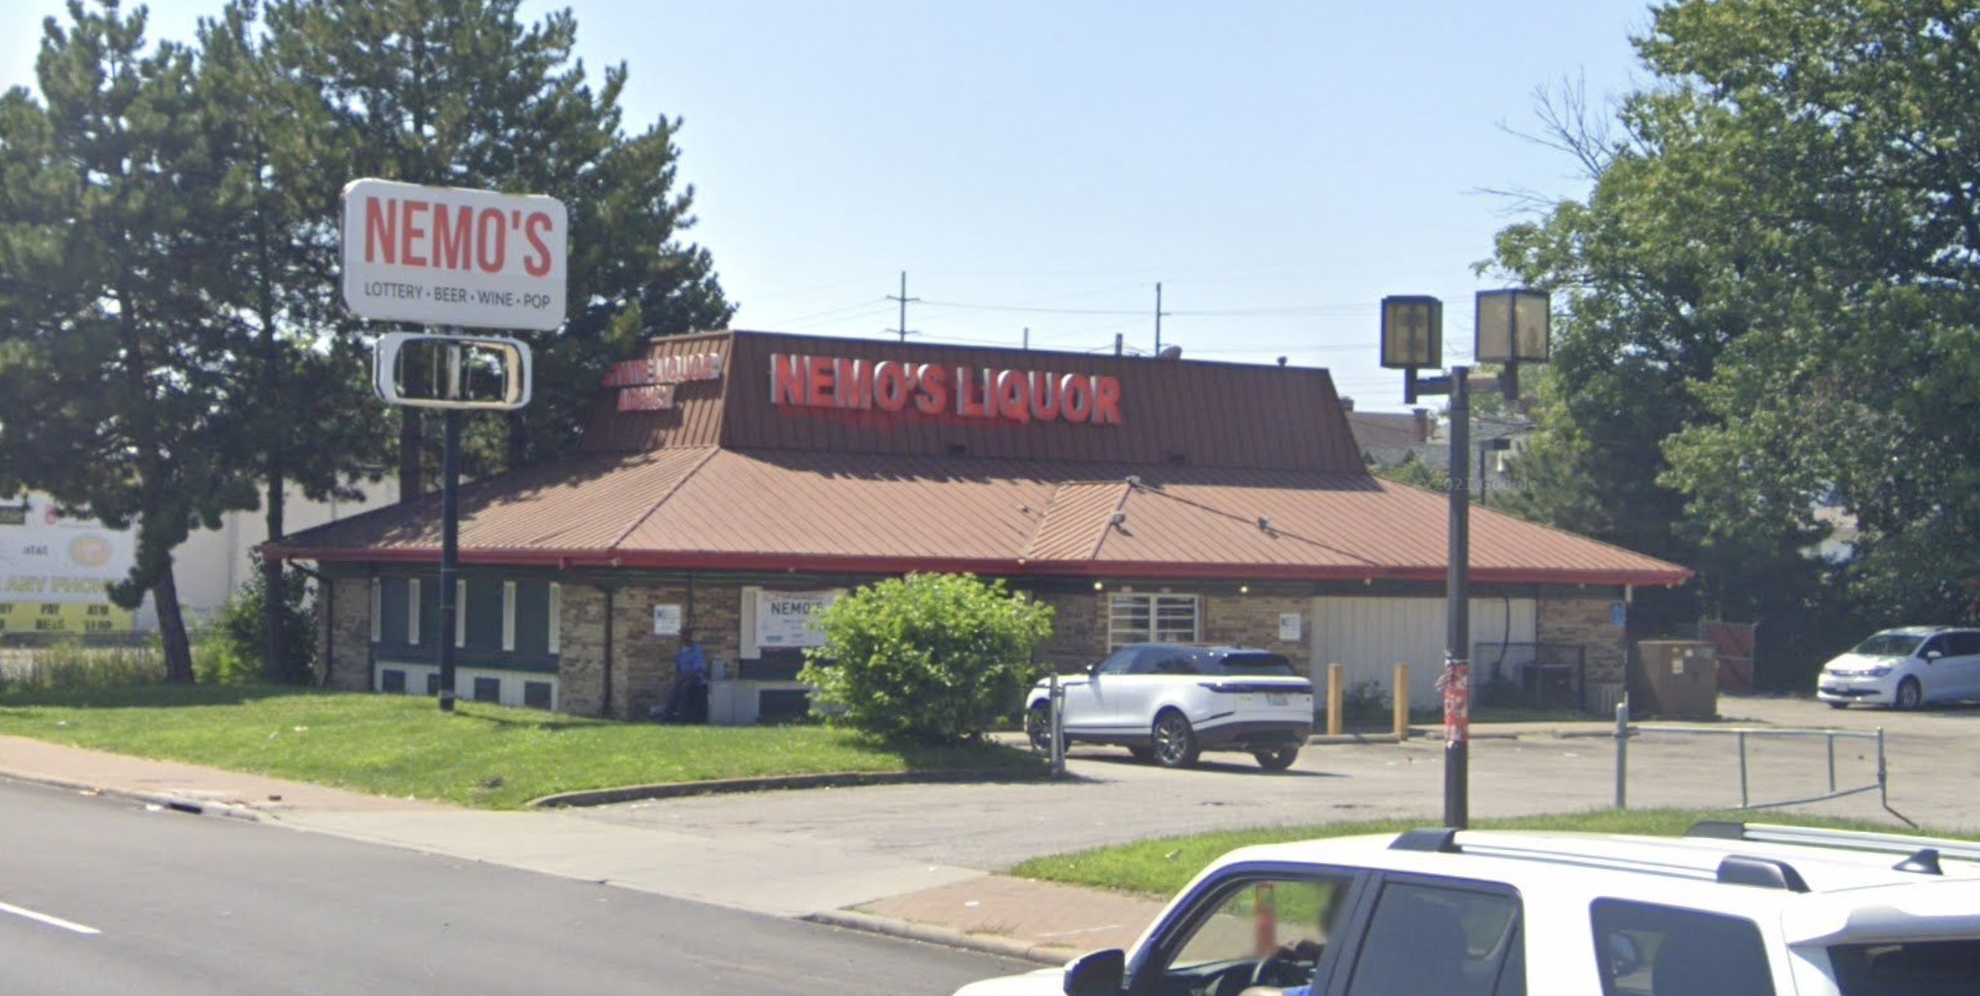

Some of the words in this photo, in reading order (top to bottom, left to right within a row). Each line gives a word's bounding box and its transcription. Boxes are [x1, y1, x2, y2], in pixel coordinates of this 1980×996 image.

[364, 196, 554, 278] NEMO'S
[364, 282, 423, 300] LOTTERY
[434, 287, 467, 303] BEER
[476, 290, 514, 307] WINE
[523, 294, 551, 309] POP
[770, 352, 947, 415] NEMO'S
[956, 366, 1123, 424] LIQUOR
